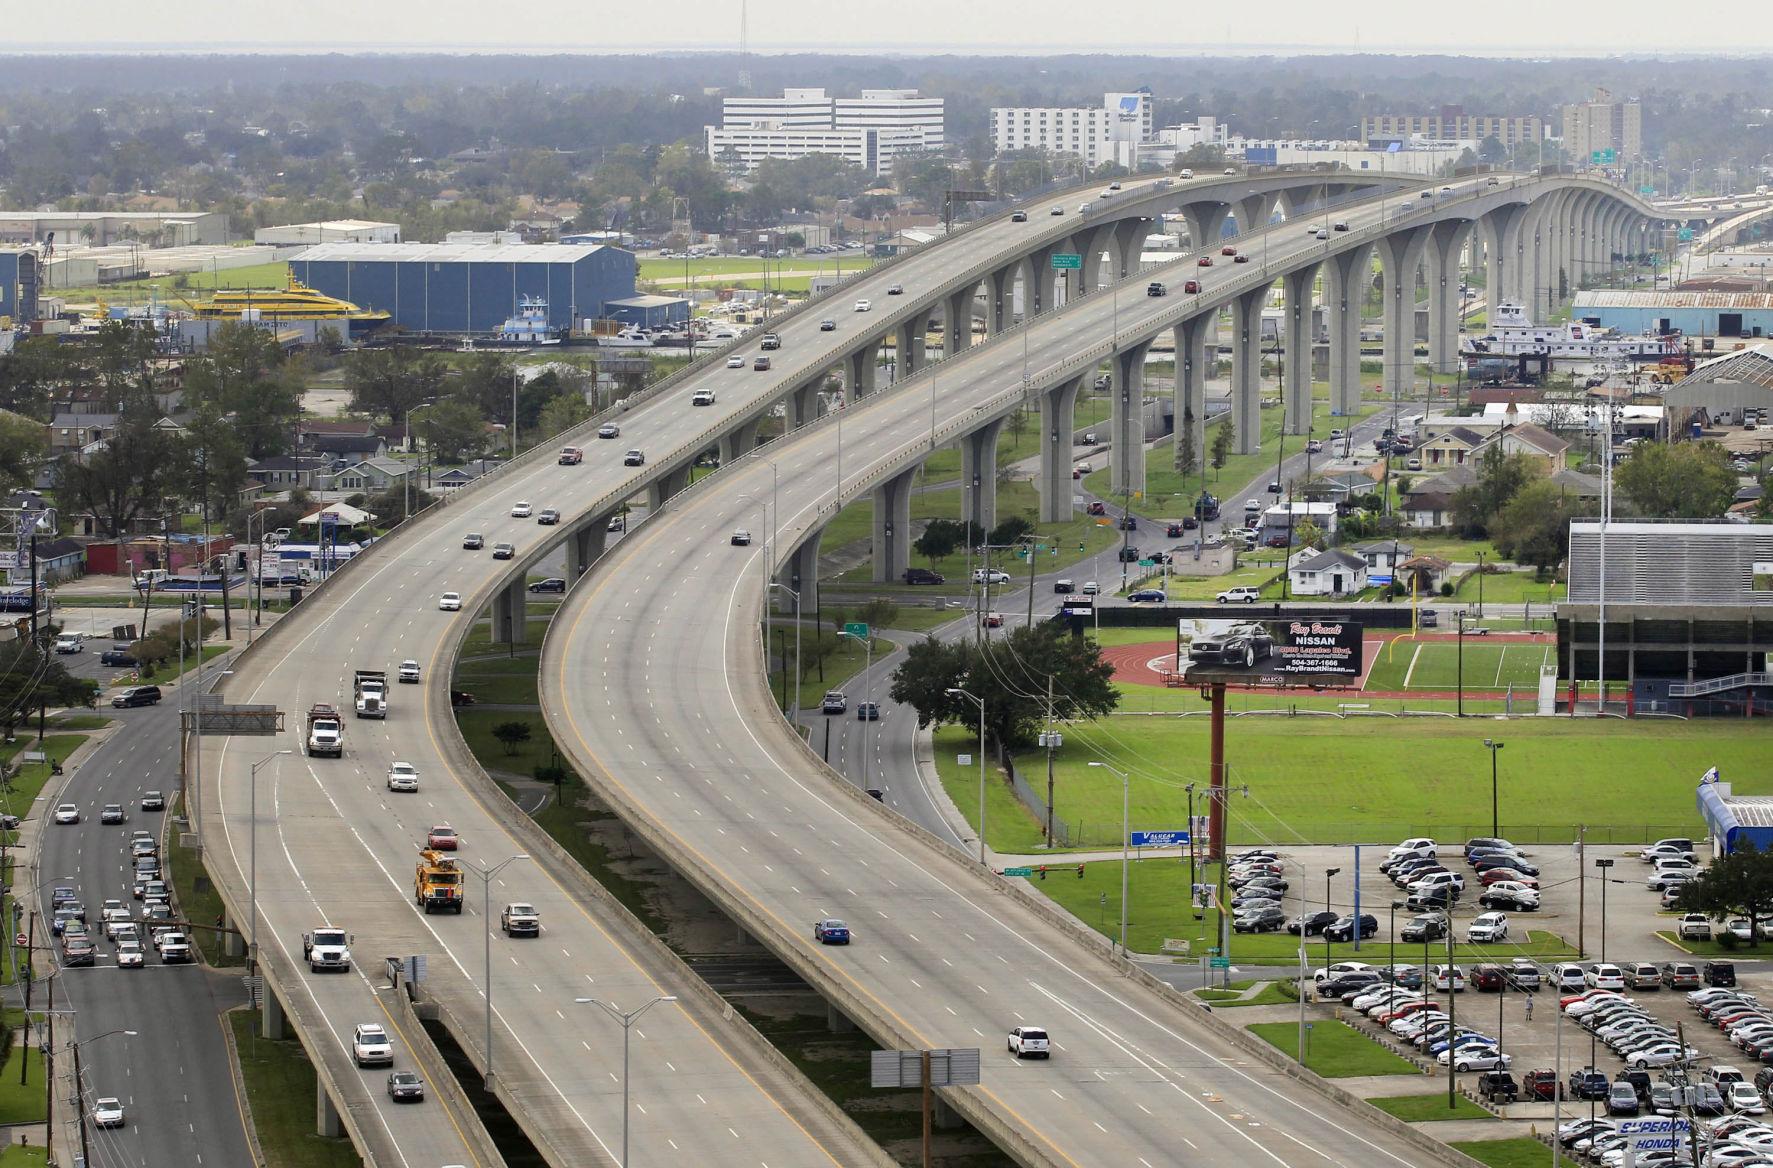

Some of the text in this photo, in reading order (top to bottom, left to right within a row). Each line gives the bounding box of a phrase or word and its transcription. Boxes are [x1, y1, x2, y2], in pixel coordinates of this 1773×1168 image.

[1290, 622, 1343, 636] Ray Brandt
[1295, 637, 1336, 645] NISSAN
[1620, 1120, 1692, 1134] SUPERIOR
[1636, 1138, 1680, 1149] HONDA
